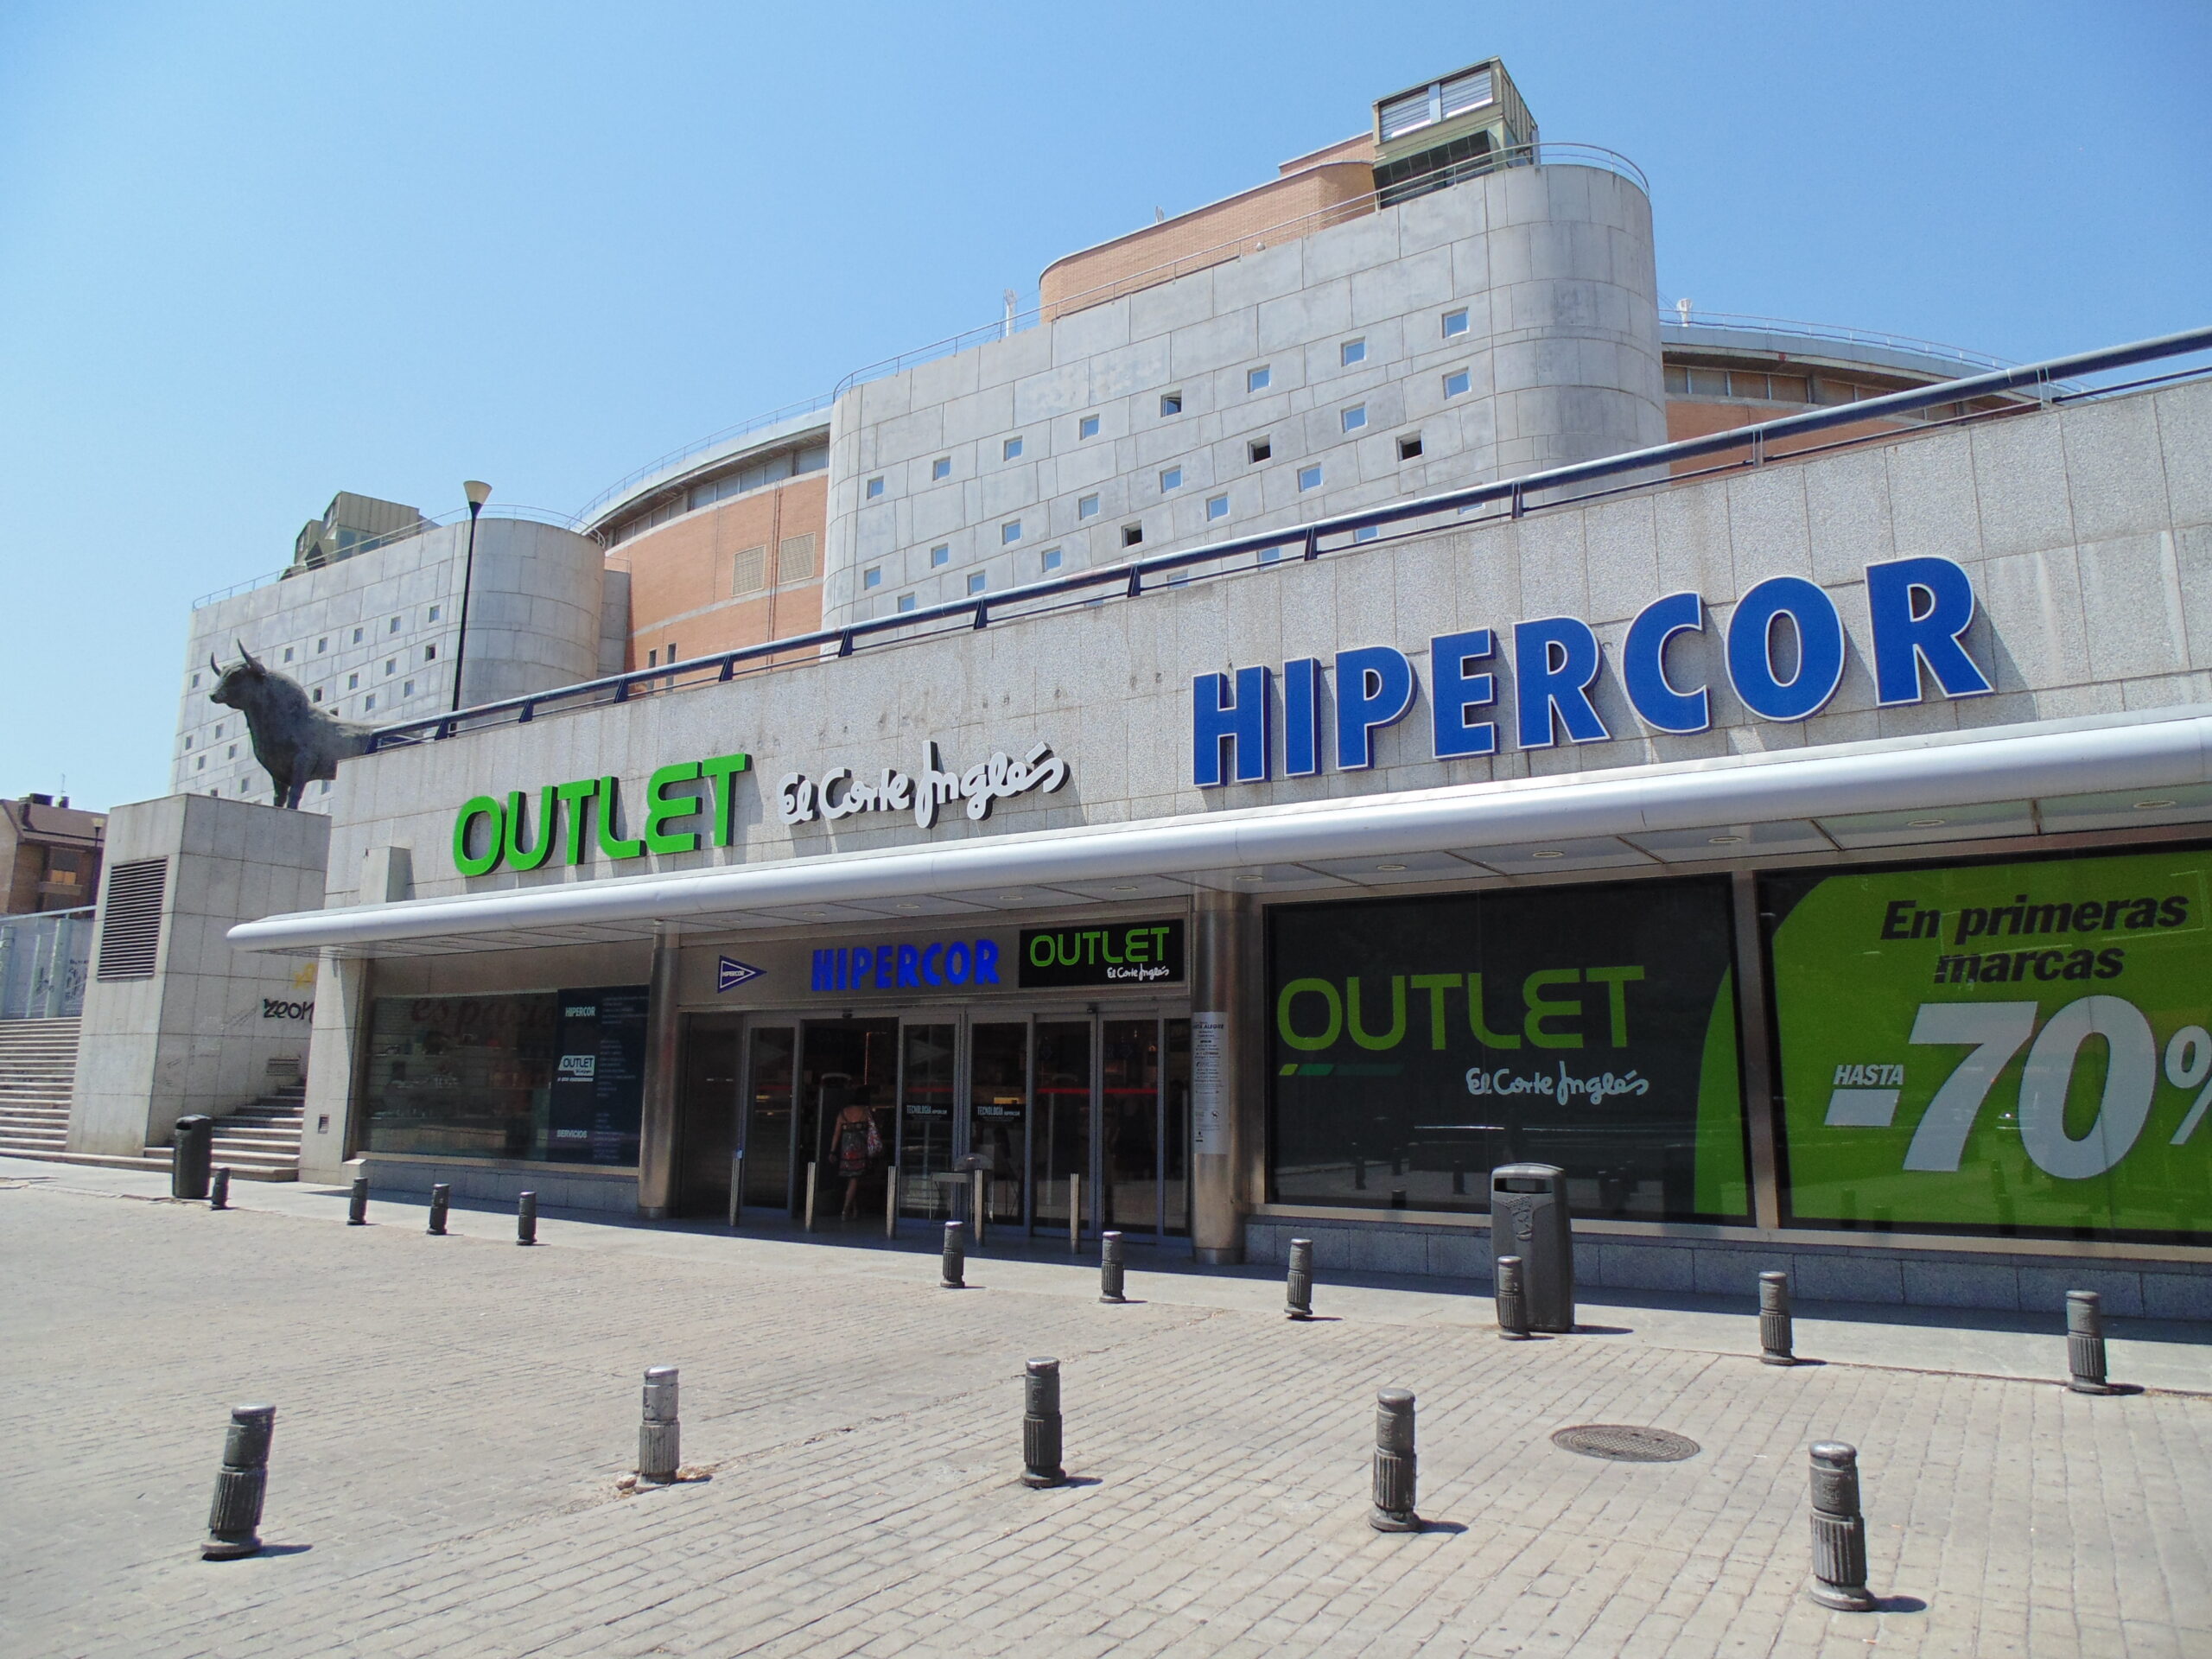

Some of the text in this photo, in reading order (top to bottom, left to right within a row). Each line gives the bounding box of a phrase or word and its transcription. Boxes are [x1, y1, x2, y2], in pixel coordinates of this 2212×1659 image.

[1192, 555, 1995, 790] HIPERCOR
[780, 740, 1071, 829] El Corte Inglés
[452, 753, 751, 876] OUTLET
[1880, 894, 2190, 945] En primeras
[811, 939, 1000, 991] HIPERCOR
[1029, 926, 1170, 967] OUTLET
[1934, 947, 2125, 984] marcas
[1107, 963, 1170, 982] El Corte Inglés
[565, 1006, 596, 1017] HIPERCOR
[1276, 965, 1645, 1052] OUTLET
[563, 1058, 594, 1068] OUTLET
[1465, 1061, 1649, 1106] El Corte Inglés
[1833, 1064, 1904, 1085] HASTA
[556, 1129, 588, 1138] SERVICIOS
